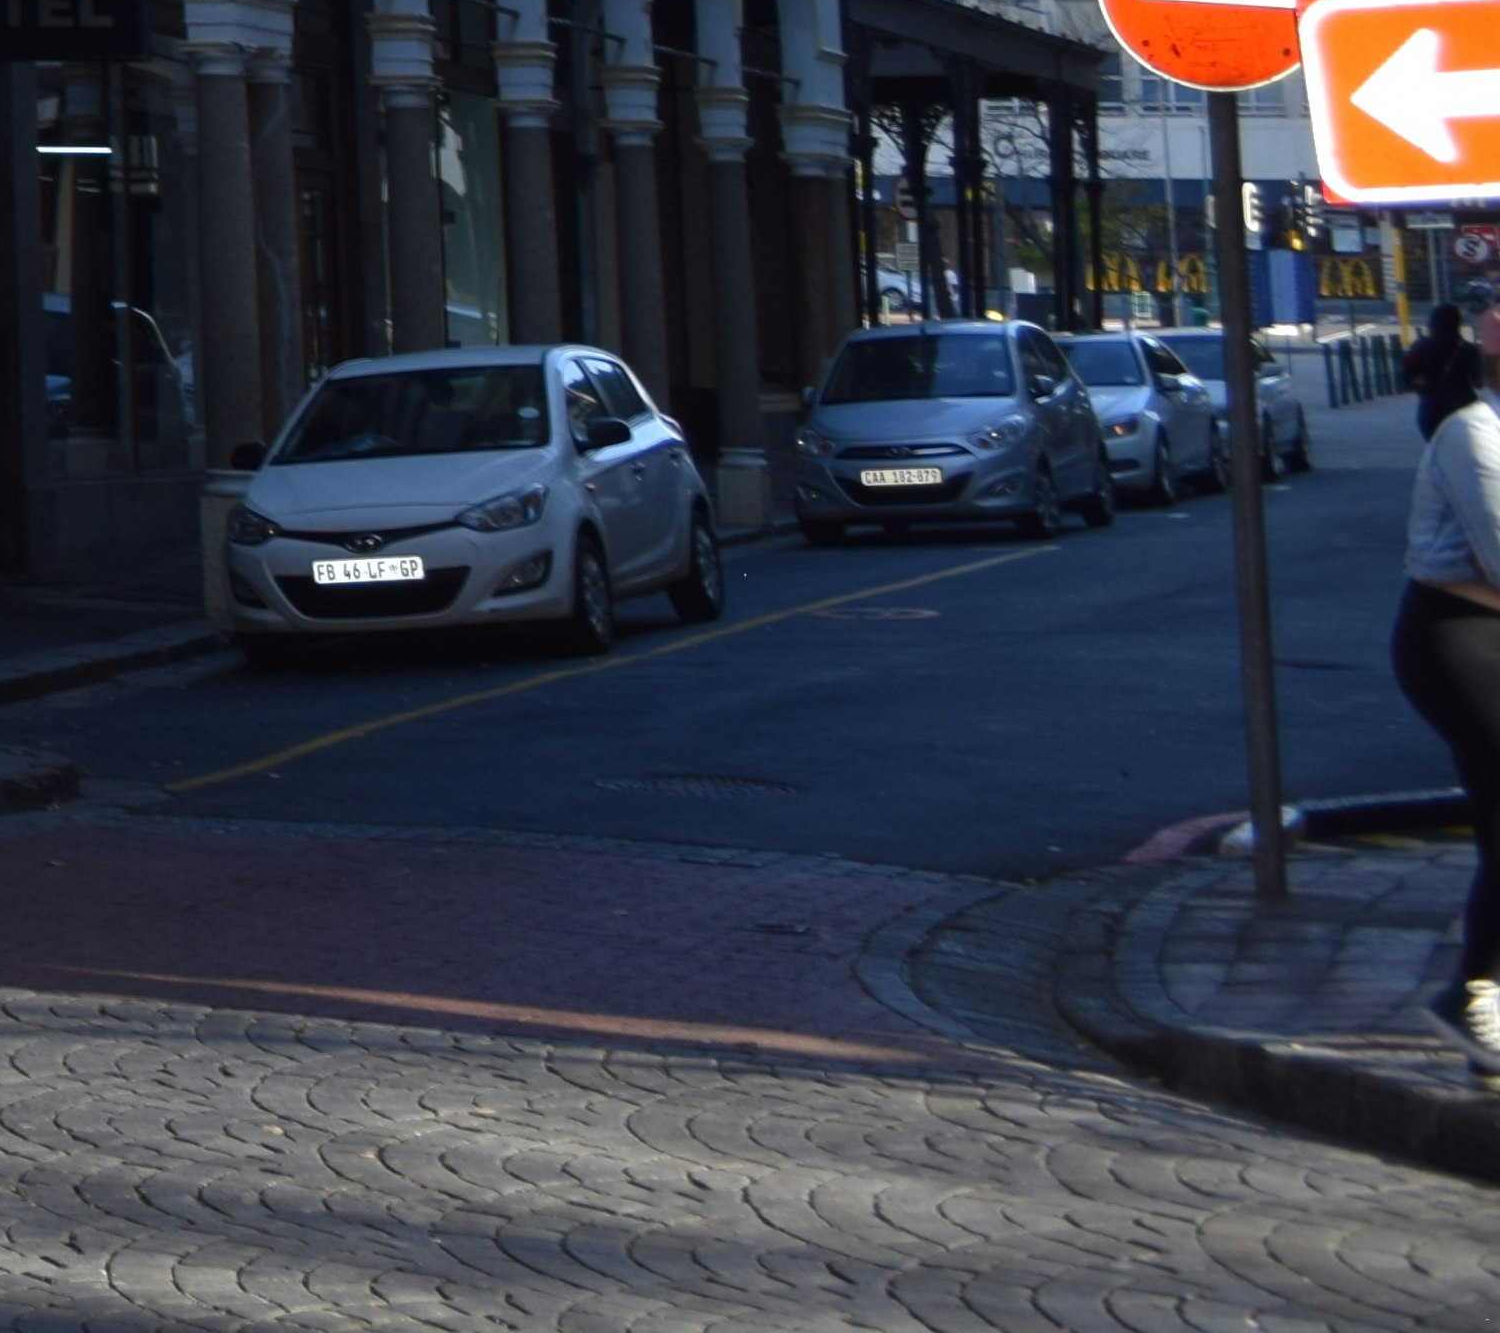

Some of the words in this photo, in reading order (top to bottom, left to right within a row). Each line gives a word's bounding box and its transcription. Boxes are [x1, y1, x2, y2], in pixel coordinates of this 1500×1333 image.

[864, 471, 886, 485] CAA
[892, 470, 938, 484] 182-879
[316, 563, 336, 582] FB
[343, 563, 361, 580] 46
[367, 561, 386, 579] LF
[399, 559, 418, 577] GP
